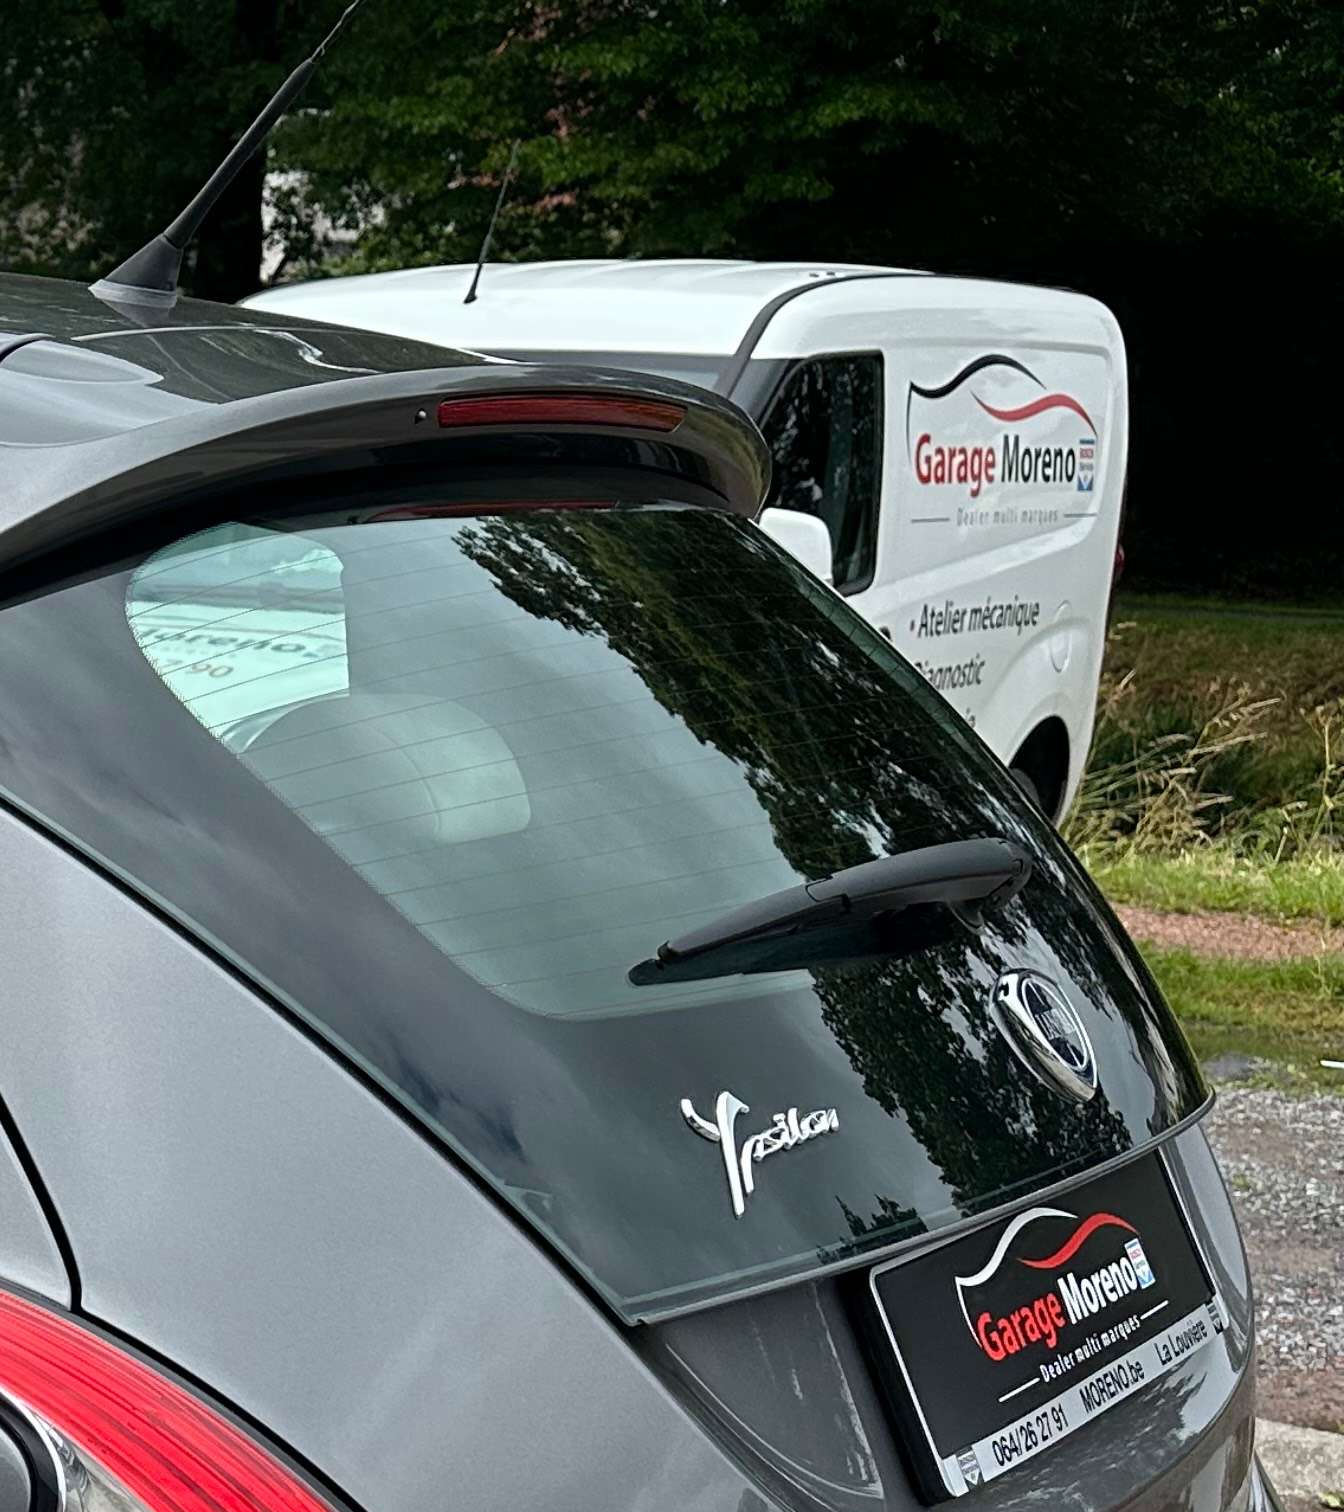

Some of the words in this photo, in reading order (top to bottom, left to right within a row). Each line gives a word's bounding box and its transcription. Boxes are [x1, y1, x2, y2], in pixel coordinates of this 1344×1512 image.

[915, 432, 996, 498] Garage
[1001, 434, 1076, 484] Moreno
[917, 600, 967, 638] Atelier
[967, 594, 1040, 636] mécanique
[680, 1090, 841, 1219] Ypsilon
[977, 1293, 1066, 1361] Garage
[1057, 1256, 1138, 1325] Moreno
[1039, 1351, 1076, 1383] Dealer
[1074, 1333, 1102, 1363] multi
[1102, 1314, 1141, 1347] marques
[1036, 1413, 1054, 1444] 27
[1052, 1402, 1069, 1432] 91
[1079, 1358, 1146, 1415] MORENO.be
[1153, 1339, 1173, 1367] La
